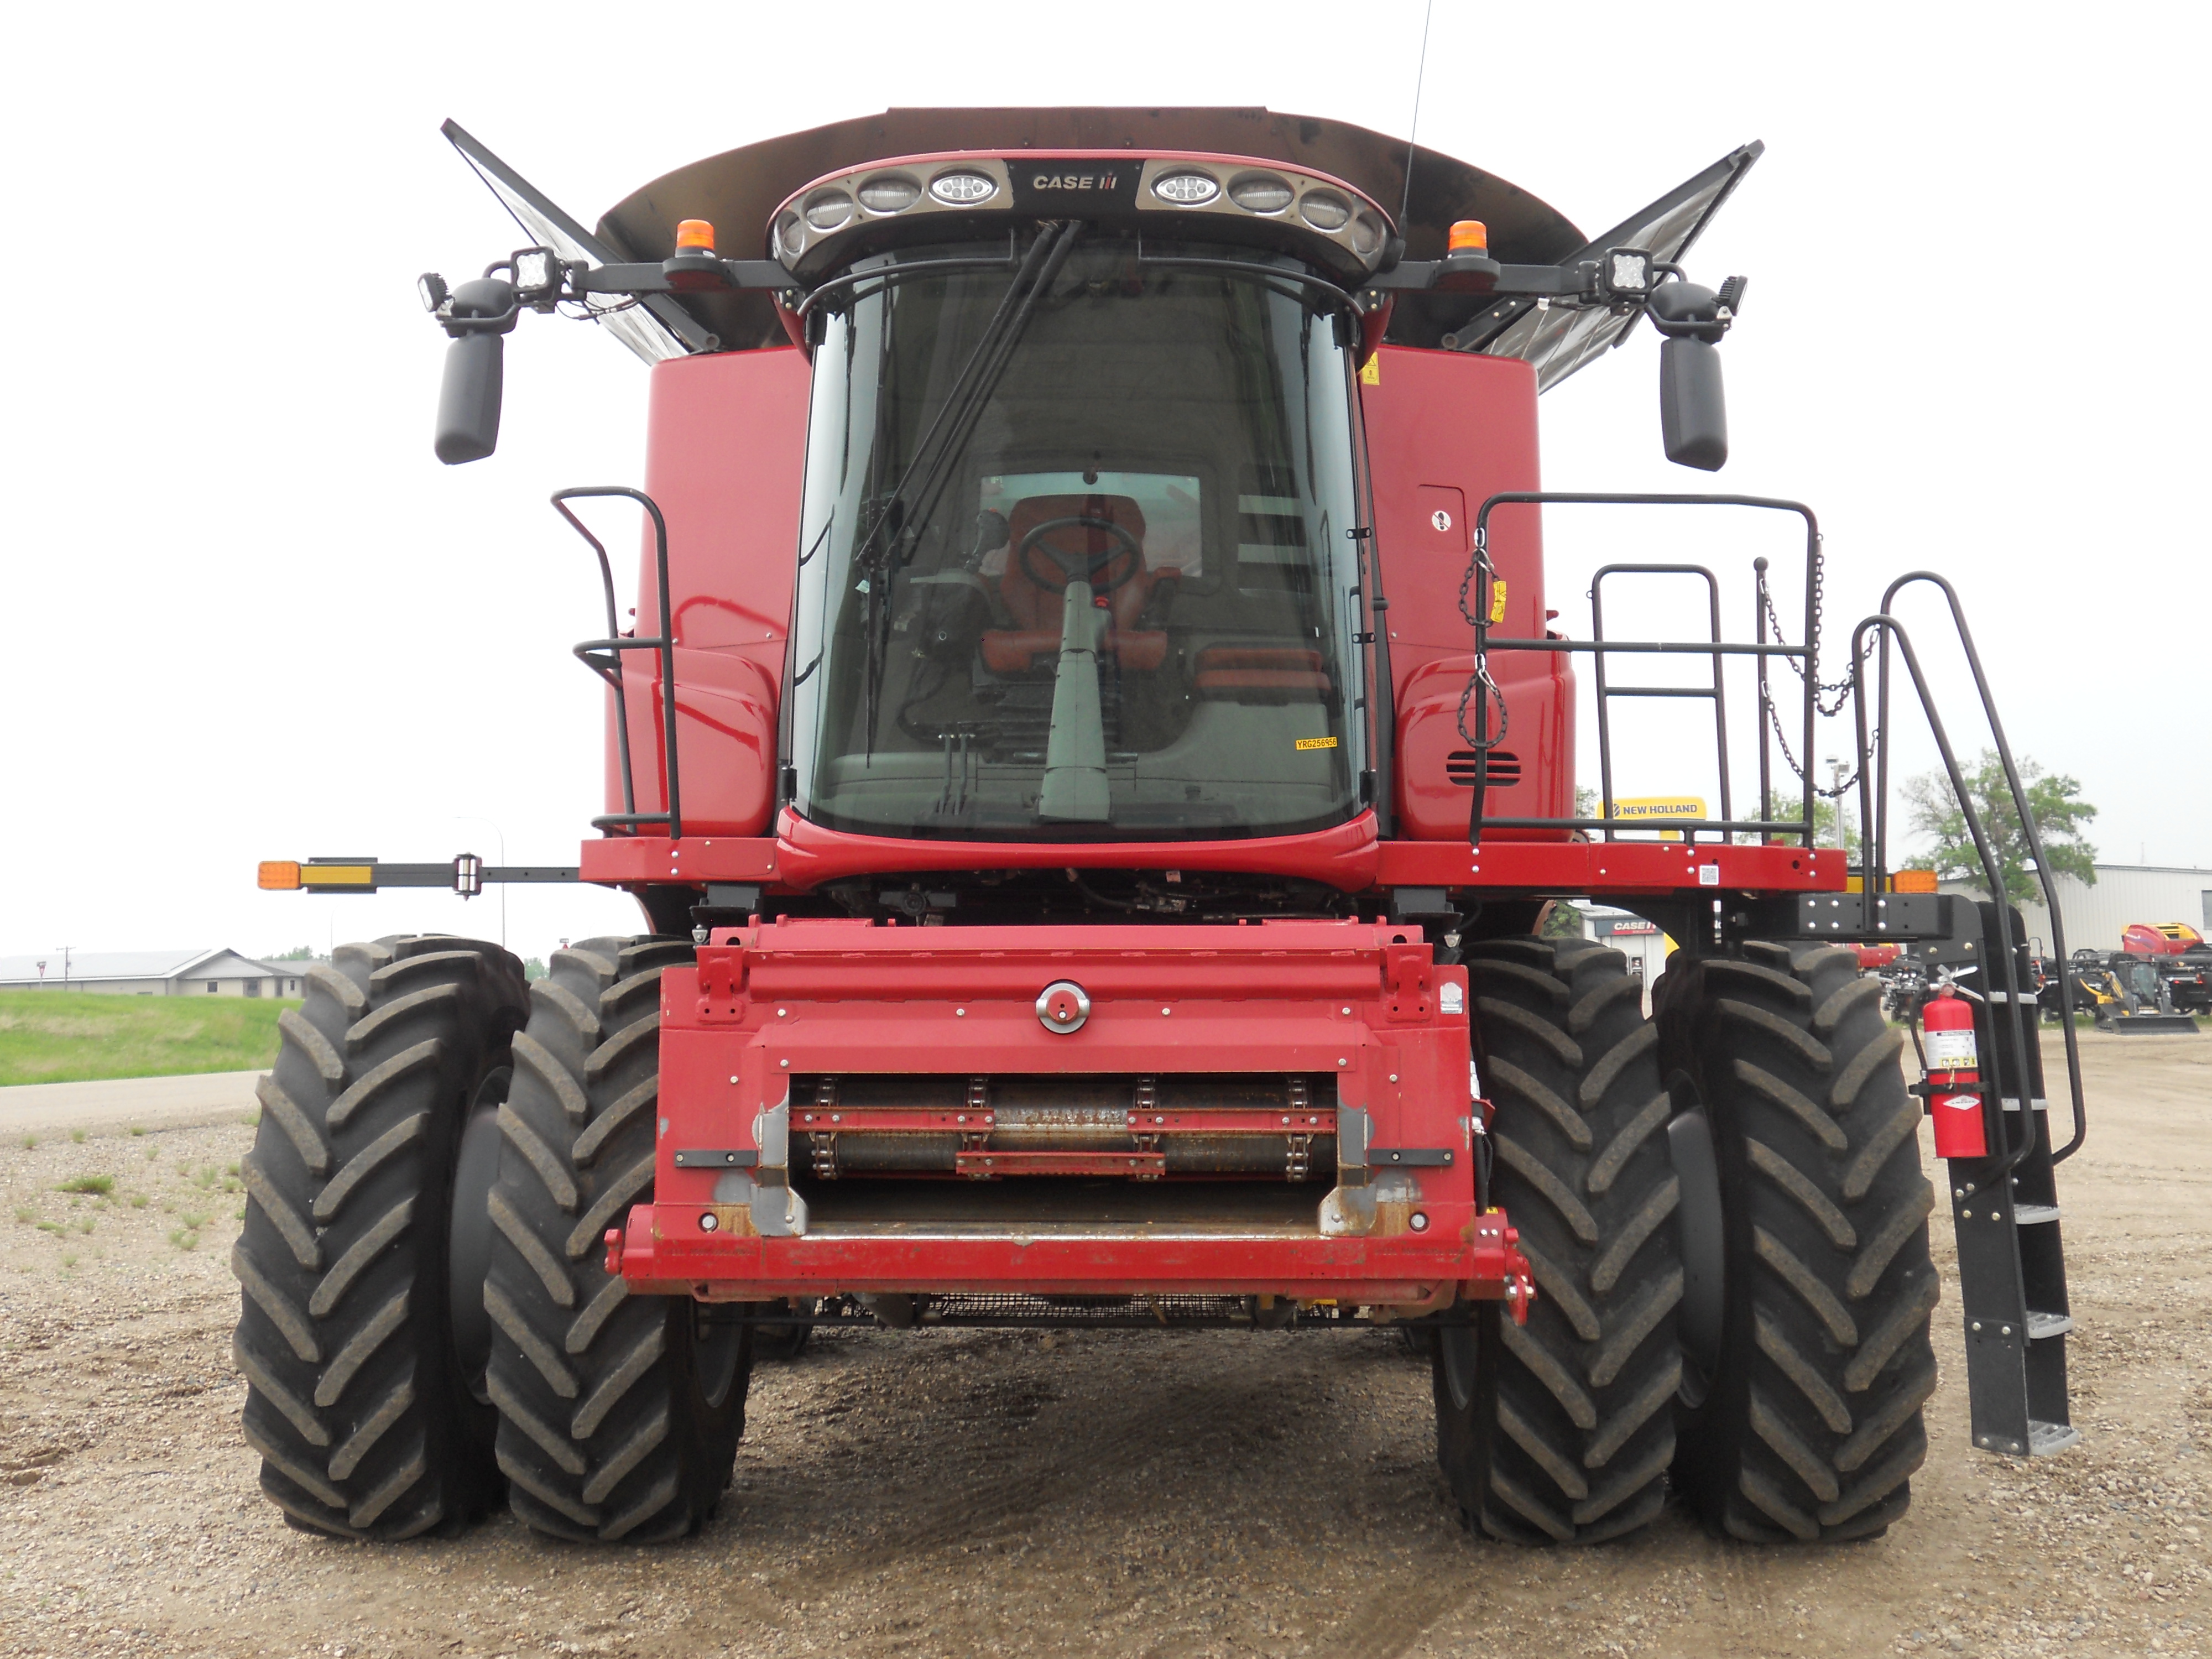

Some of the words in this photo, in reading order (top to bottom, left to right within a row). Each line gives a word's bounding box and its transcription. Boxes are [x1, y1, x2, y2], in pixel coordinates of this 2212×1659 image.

[1033, 175, 1093, 189] CASE
[1297, 738, 1337, 749] YRG256956
[1623, 806, 1647, 815] NEW
[1650, 804, 1697, 814] HOLLAND
[1614, 921, 1646, 930] CASE
